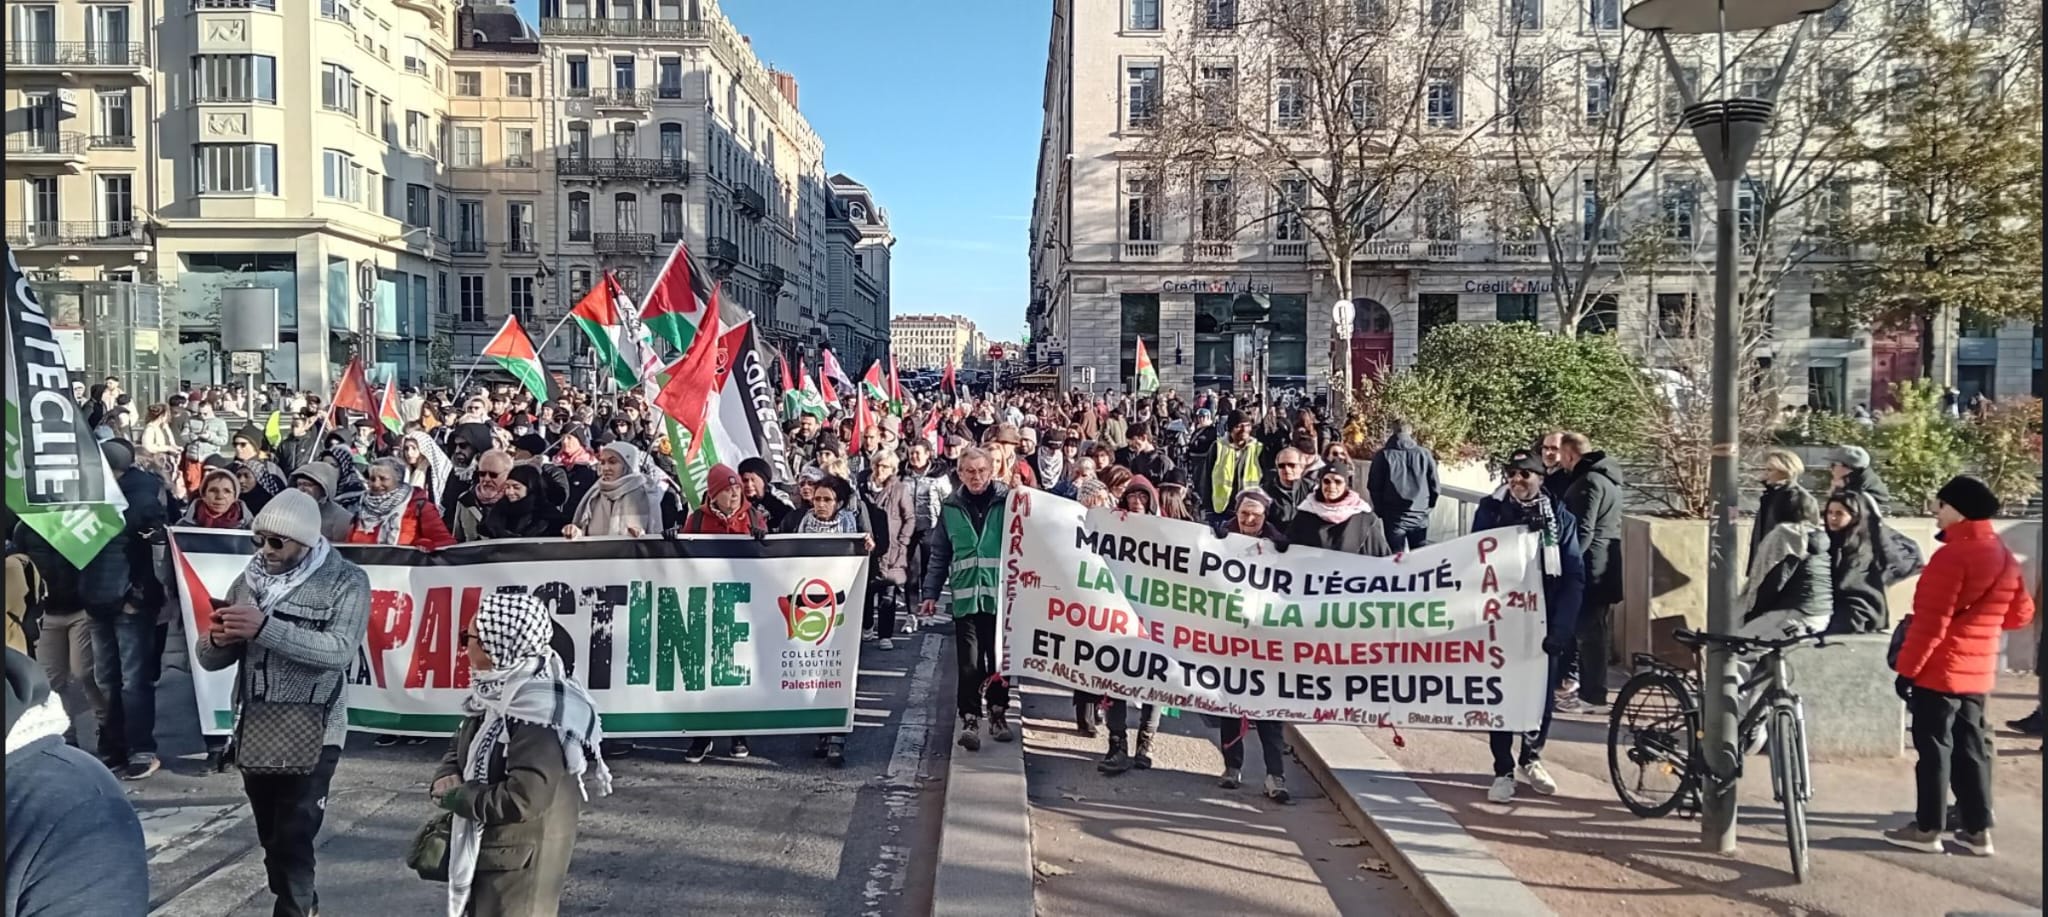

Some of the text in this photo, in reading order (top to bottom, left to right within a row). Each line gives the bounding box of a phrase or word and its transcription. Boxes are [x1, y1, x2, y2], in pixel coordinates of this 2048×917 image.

[1162, 279, 1206, 292] Crédit
[1465, 279, 1509, 292] Crédit
[743, 350, 789, 481] COLLECTIF
[1002, 491, 1032, 672] MARSEILLE
[1075, 526, 1191, 574] MARCHE
[1199, 551, 1293, 595] POUR
[1077, 560, 1455, 631] LA LIBERTÉ, LA JUSTICE,
[782, 650, 841, 658] COLLECTIF
[1048, 597, 1129, 635] POUR
[1137, 616, 1165, 644] LE
[1173, 626, 1284, 661] PEUPLE
[781, 679, 842, 689] Palestinien
[801, 669, 841, 677] PEUPLE
[1032, 629, 1504, 705] ET POUR TOUS LES PEUPLES
